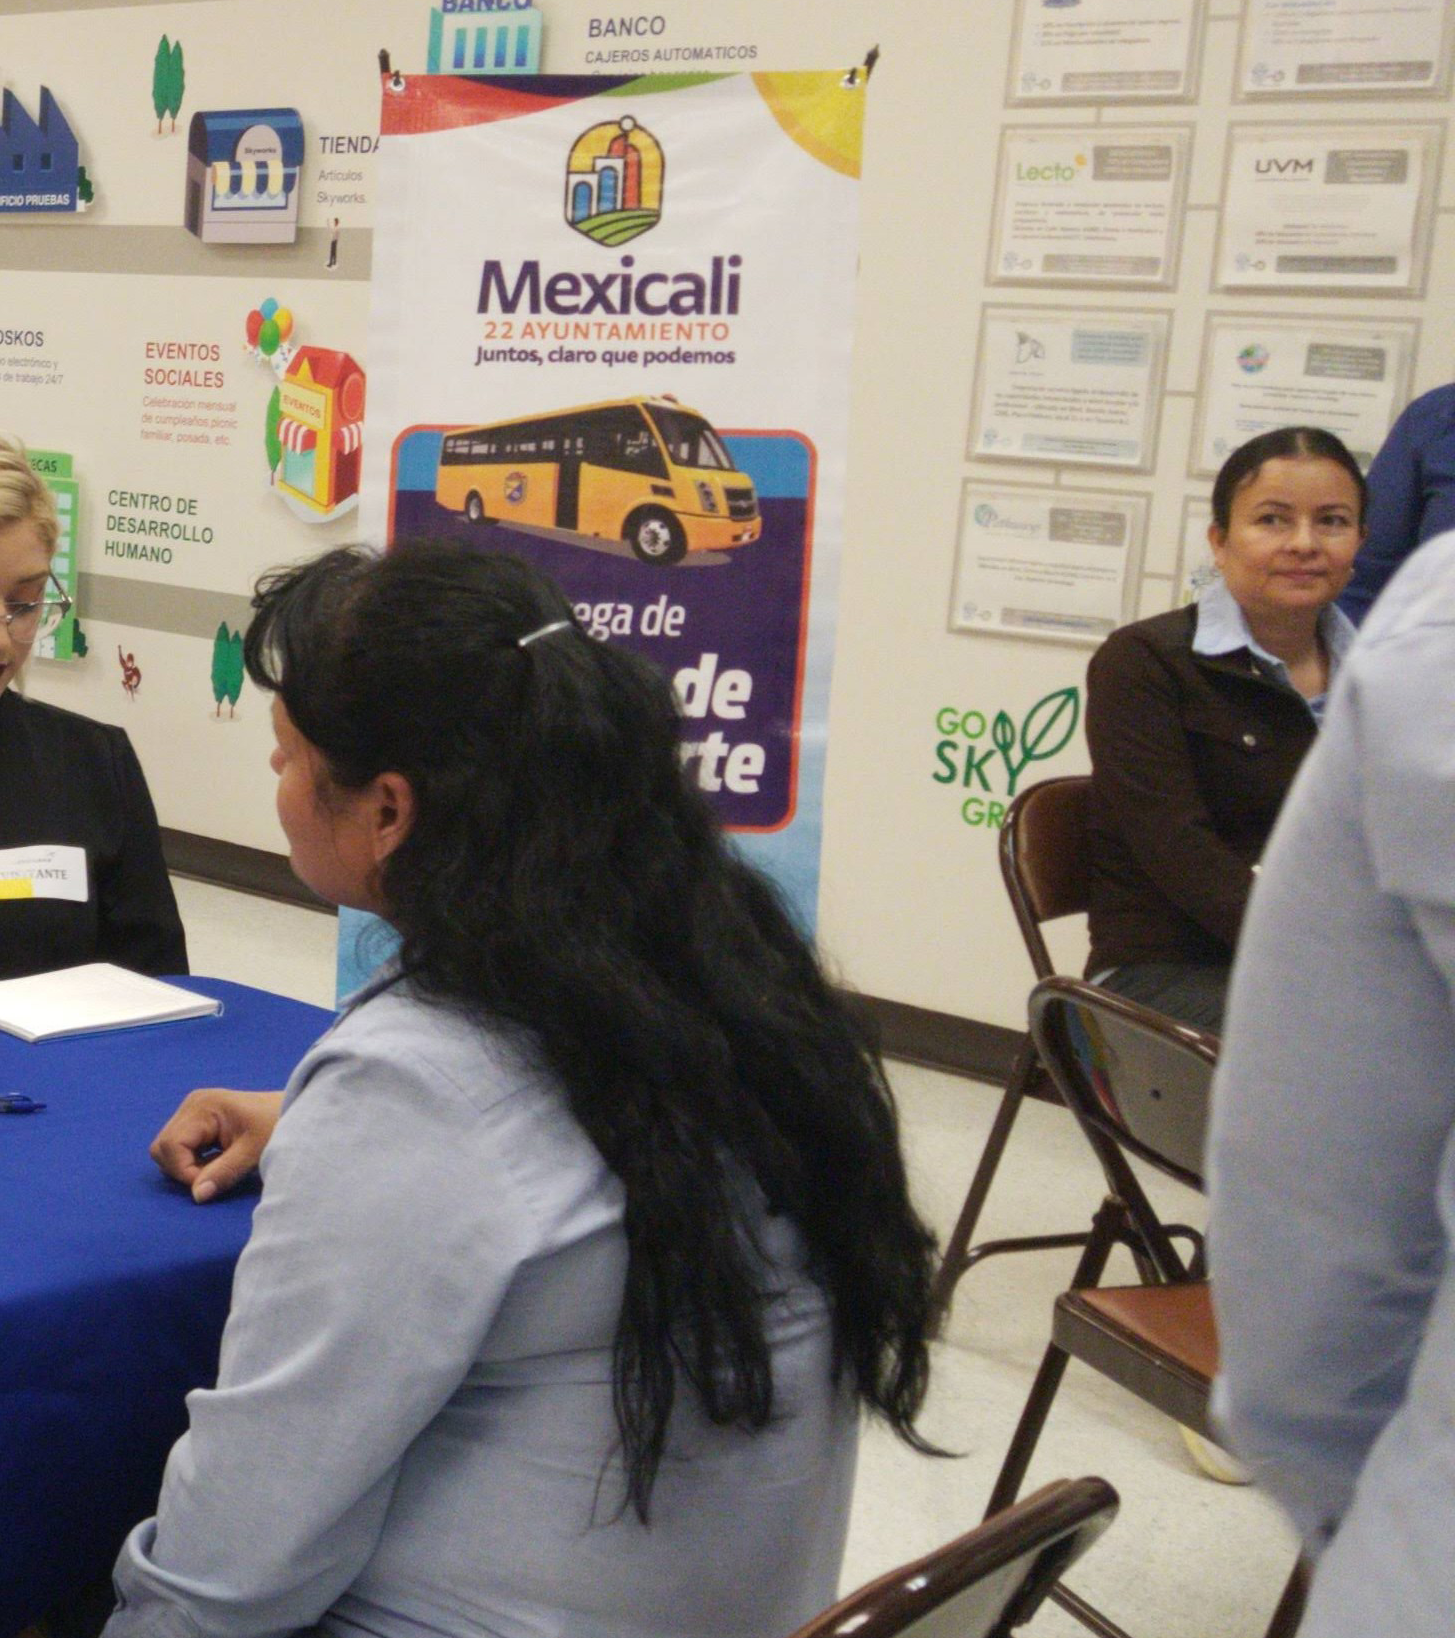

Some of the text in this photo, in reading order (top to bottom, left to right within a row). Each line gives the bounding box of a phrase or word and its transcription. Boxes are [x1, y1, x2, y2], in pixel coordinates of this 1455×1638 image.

[587, 16, 666, 38] BANCO
[585, 45, 758, 64] CAJEROS AUTOMATICOS
[1015, 162, 1076, 181] Lecto
[1254, 158, 1314, 174] UVM
[26, 194, 70, 206] PRUEBAS
[477, 254, 742, 316] Mexicali
[484, 321, 730, 341] 22 AYUNTAMIENTO
[145, 342, 220, 362] EVENTOS
[474, 346, 736, 368] Juntos, claro que podemos
[144, 368, 224, 389] SOCIALES
[283, 394, 322, 419] EVENTOS
[108, 489, 198, 516] CENTRO DE
[106, 515, 214, 544] DESARROLLO
[105, 540, 173, 565] HUMANO
[640, 594, 686, 637] de
[935, 706, 987, 740] GO
